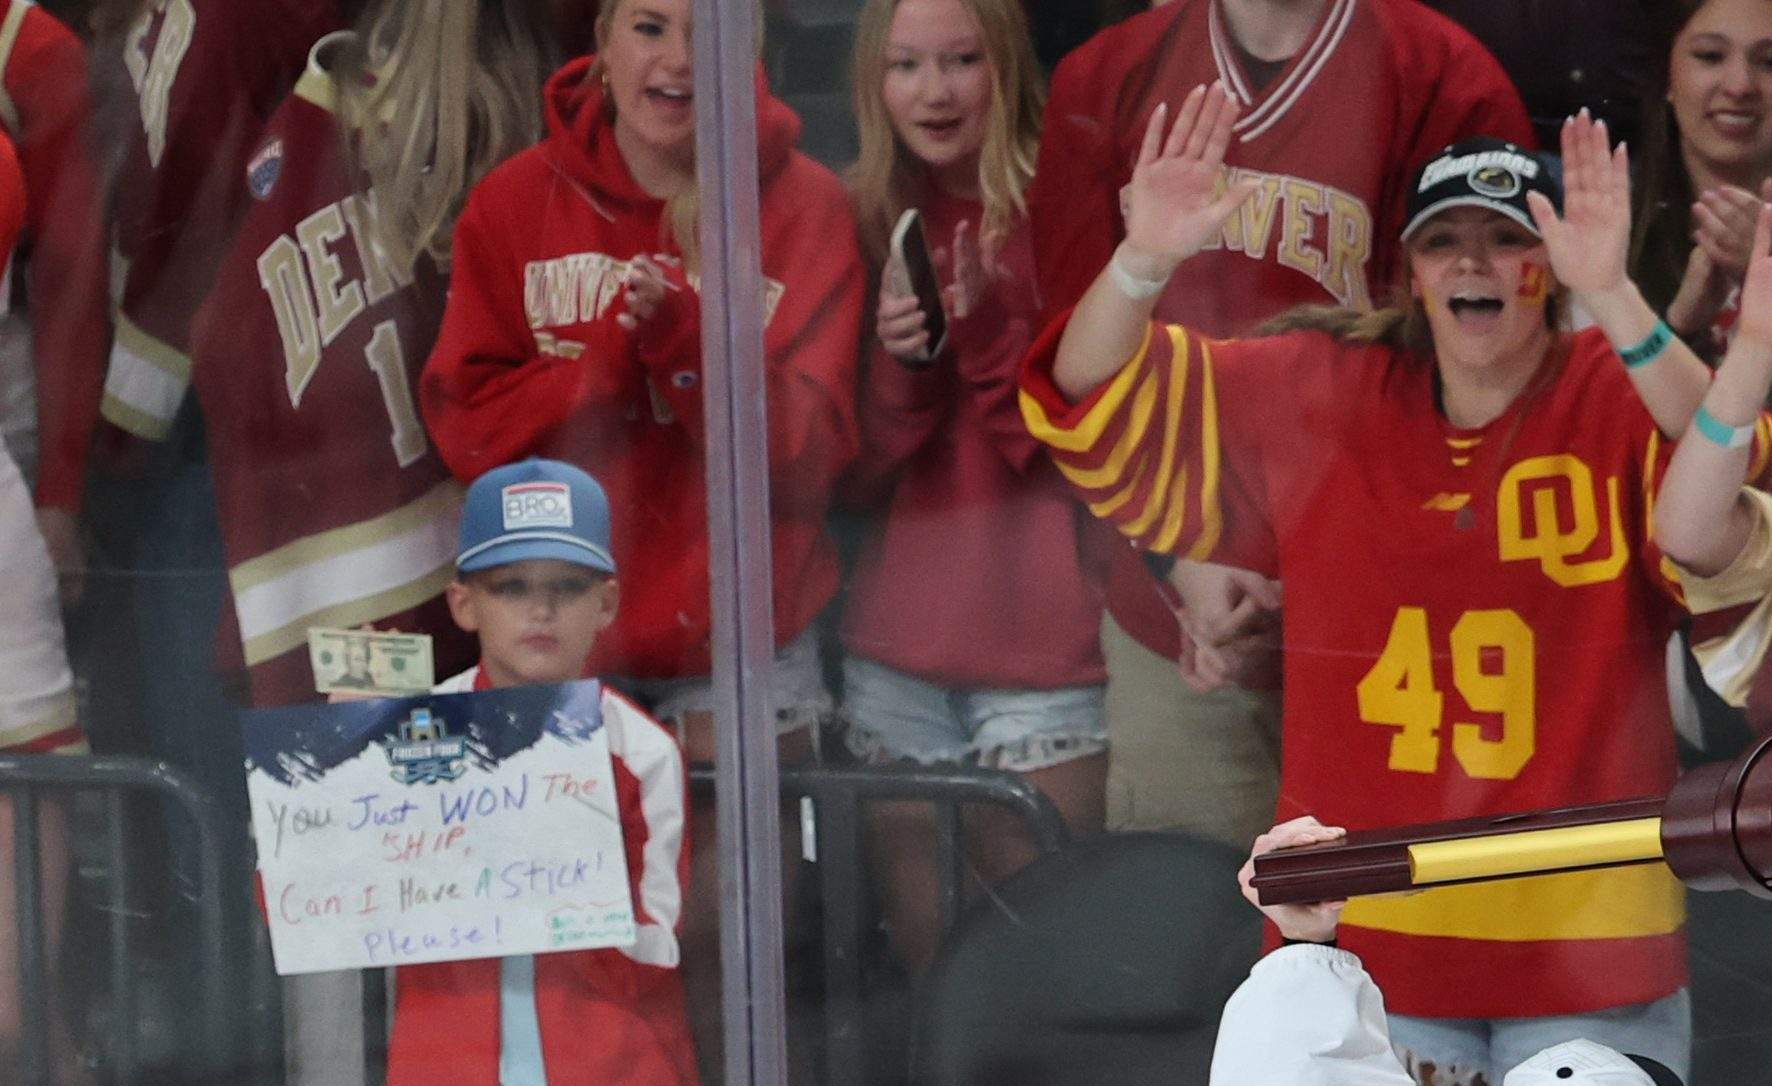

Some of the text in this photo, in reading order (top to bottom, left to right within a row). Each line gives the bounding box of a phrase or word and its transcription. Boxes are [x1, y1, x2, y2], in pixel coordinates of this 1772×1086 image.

[1356, 604, 1536, 780] 49
[268, 799, 333, 858] You
[347, 793, 419, 831] Just
[440, 773, 529, 826] WON
[279, 883, 342, 925] Can
[356, 884, 379, 915] I
[399, 877, 462, 914] Have
[473, 866, 493, 899] A
